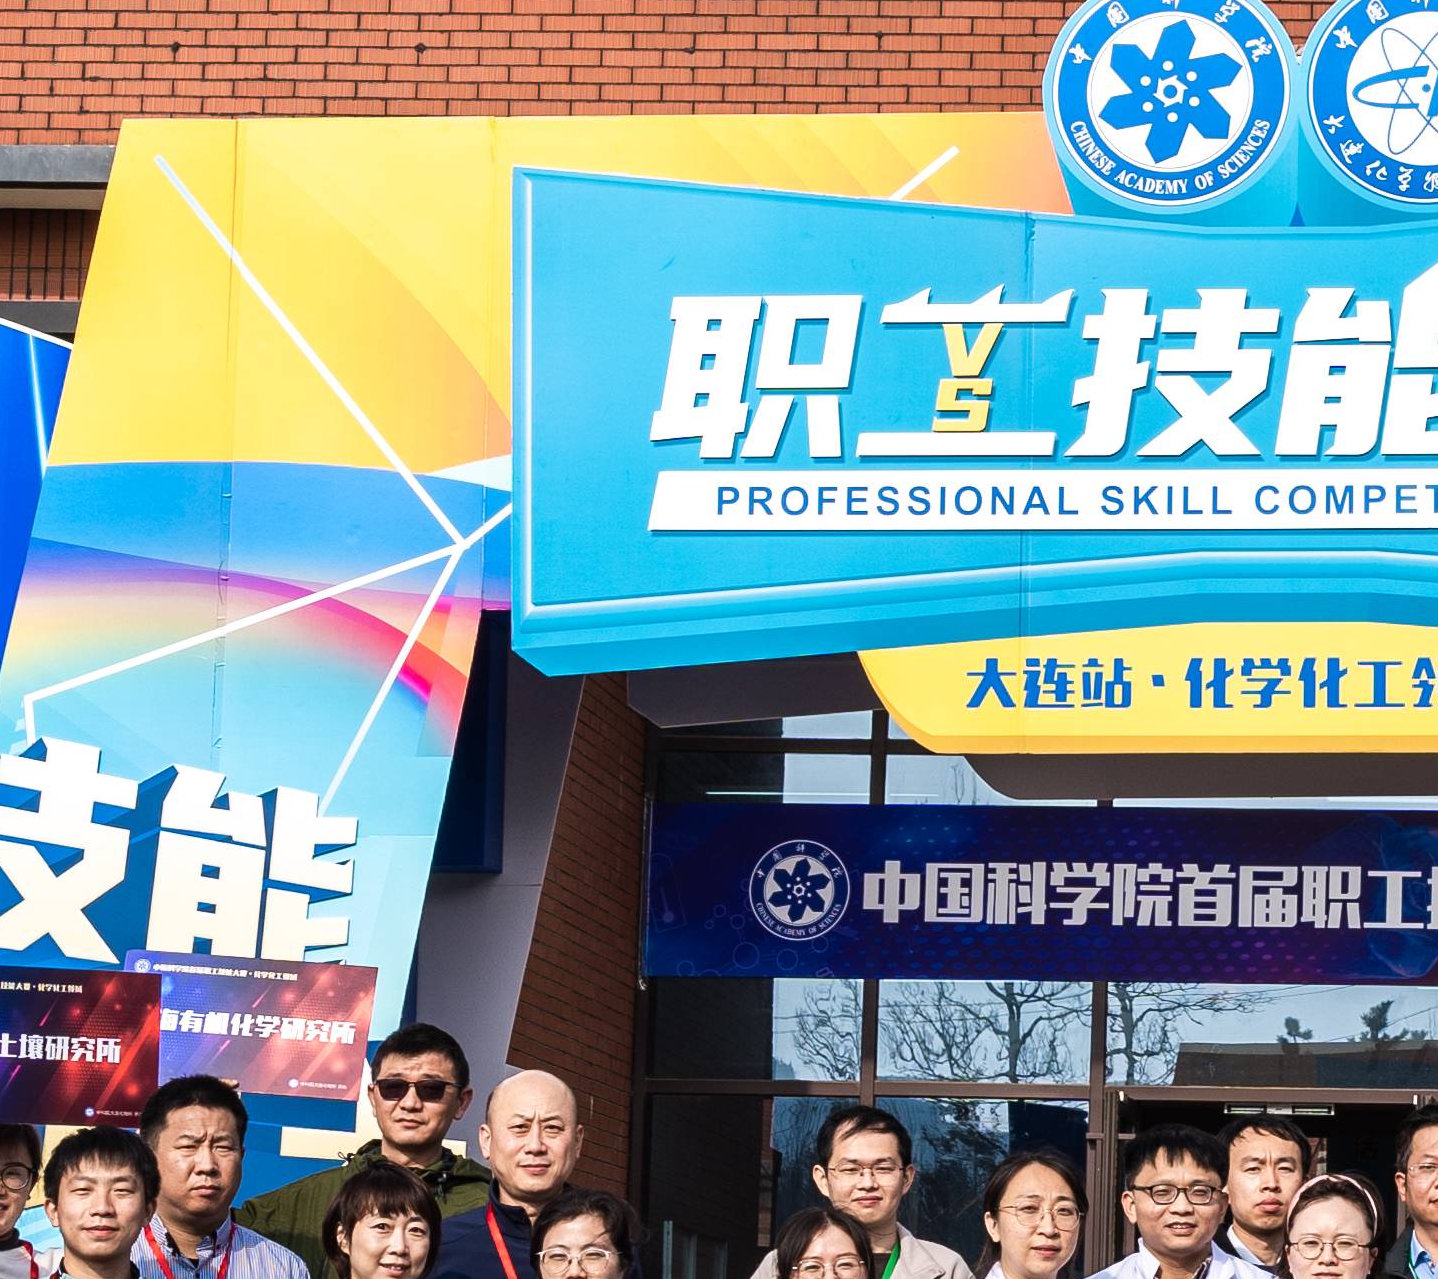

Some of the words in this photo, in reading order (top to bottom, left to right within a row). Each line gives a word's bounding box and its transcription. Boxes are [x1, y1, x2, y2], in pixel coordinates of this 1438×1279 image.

[1069, 119, 1113, 178] CHINESE
[1114, 167, 1189, 196] ACADEMY
[1193, 170, 1216, 192] OF
[1218, 118, 1272, 180] SCIENCES
[716, 485, 1080, 517] PROFESSIONAL
[1101, 485, 1233, 516] SKILL
